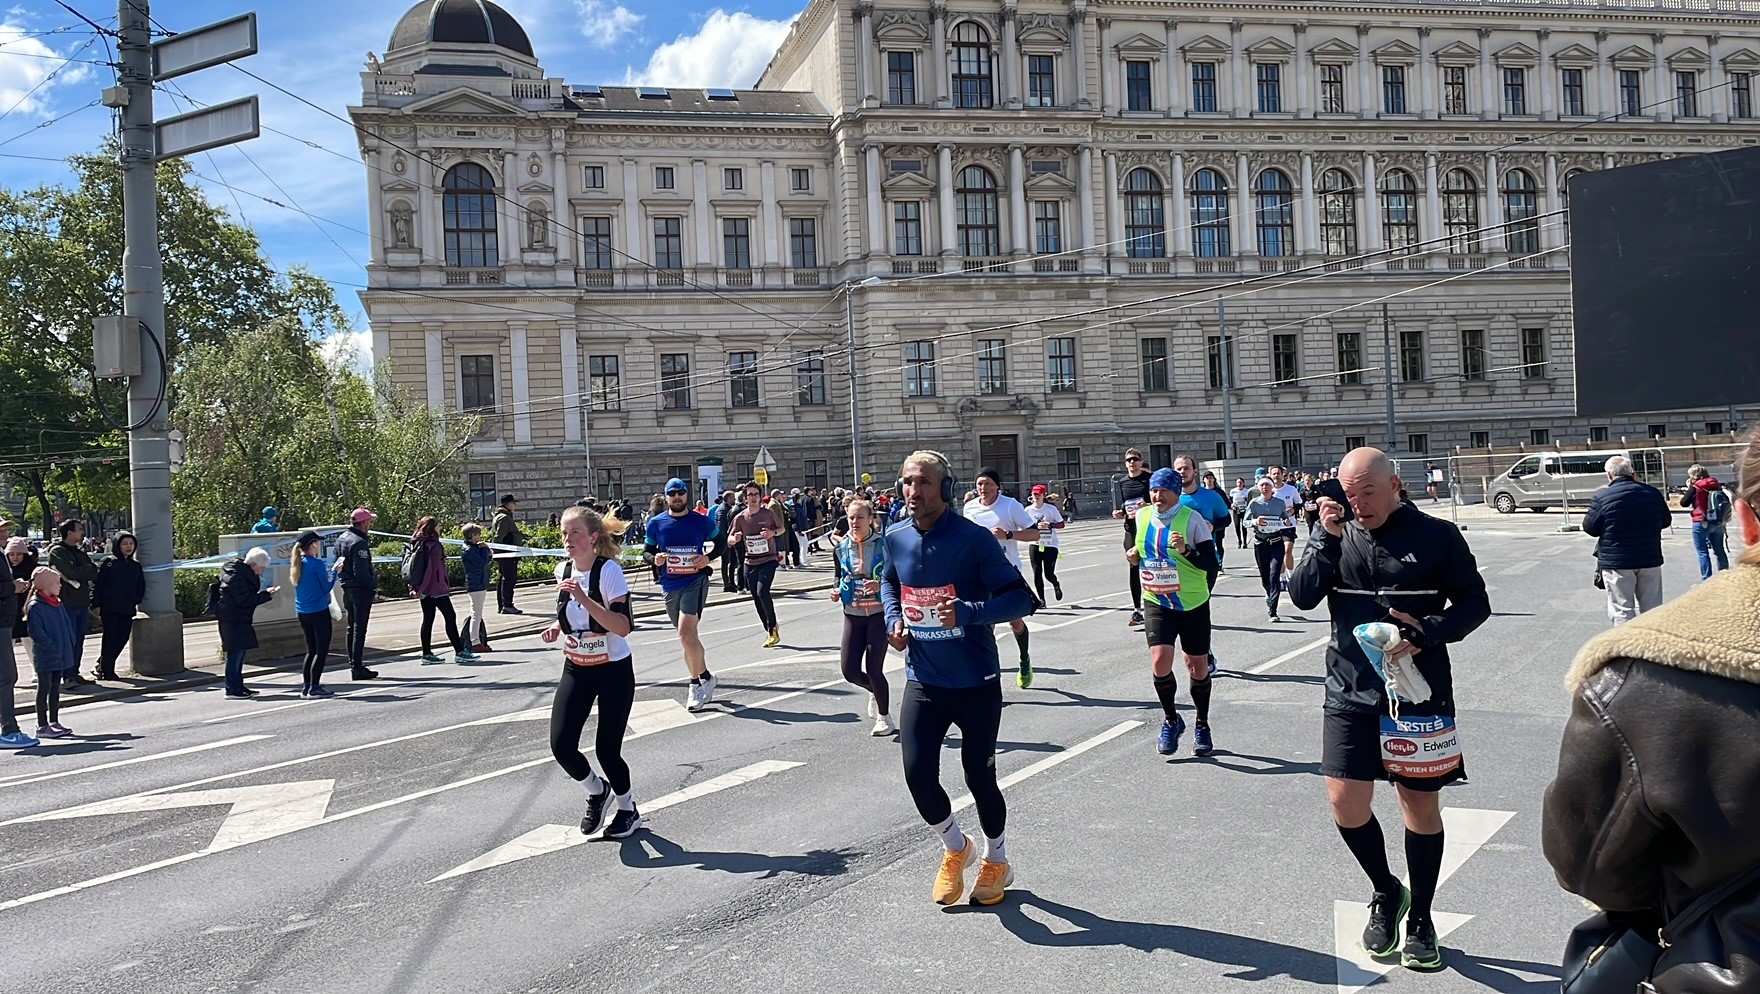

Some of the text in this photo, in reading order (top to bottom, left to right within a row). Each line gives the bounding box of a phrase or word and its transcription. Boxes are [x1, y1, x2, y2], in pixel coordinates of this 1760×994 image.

[579, 640, 605, 650] Angela
[1396, 721, 1433, 732] ERSTE
[1386, 741, 1416, 752] Hervis
[1423, 736, 1456, 752] Edward
